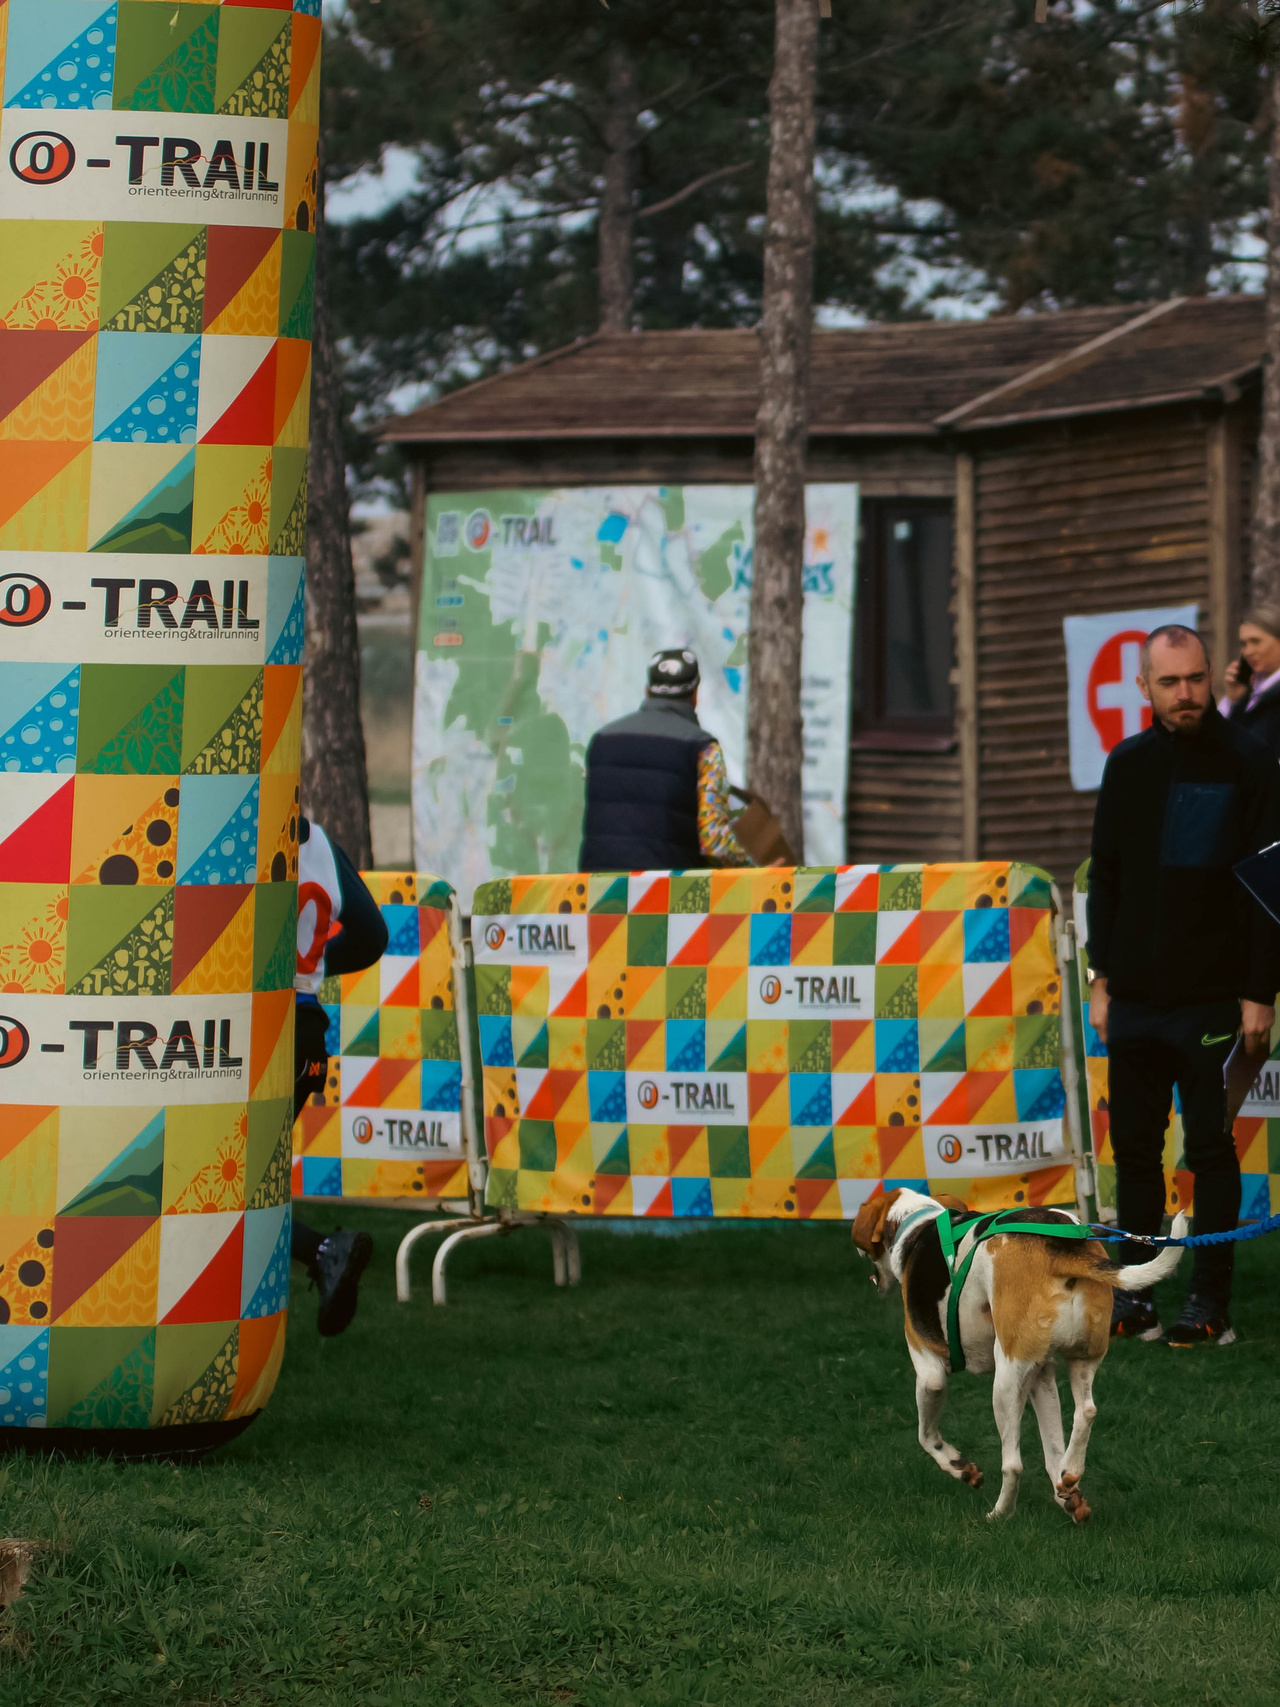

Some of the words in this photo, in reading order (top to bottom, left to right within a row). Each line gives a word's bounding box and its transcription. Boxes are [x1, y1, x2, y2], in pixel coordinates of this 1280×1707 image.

[128, 186, 278, 204] orienteering&trailrunning
[104, 627, 259, 642] orienteering&trailrunning
[83, 1066, 242, 1083] orienteering&trailrunning
